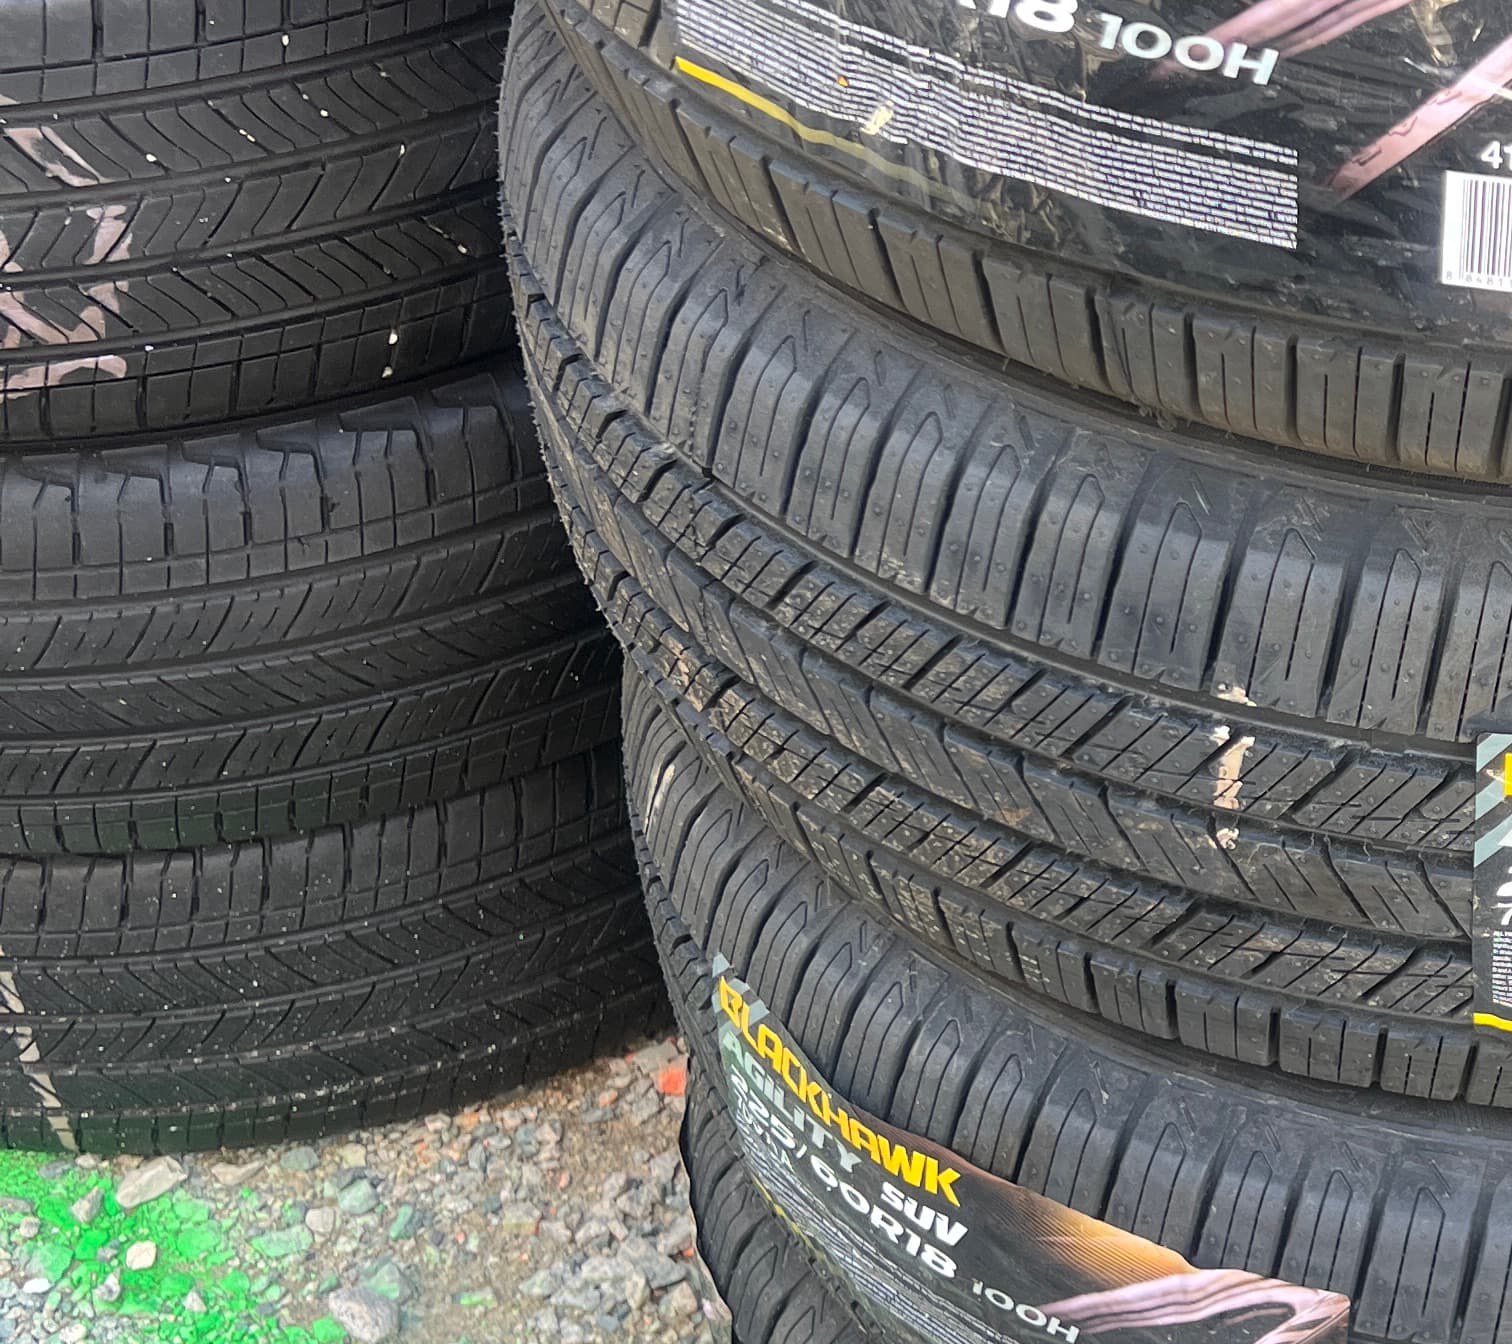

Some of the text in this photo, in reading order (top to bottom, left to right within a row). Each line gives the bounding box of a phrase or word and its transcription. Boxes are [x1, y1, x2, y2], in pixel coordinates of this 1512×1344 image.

[1100, 11, 1279, 86] 100H
[719, 976, 961, 1208] BLACKHAWK
[722, 1030, 969, 1247] AGILITY SUV
[731, 1064, 959, 1280] 225/60R18
